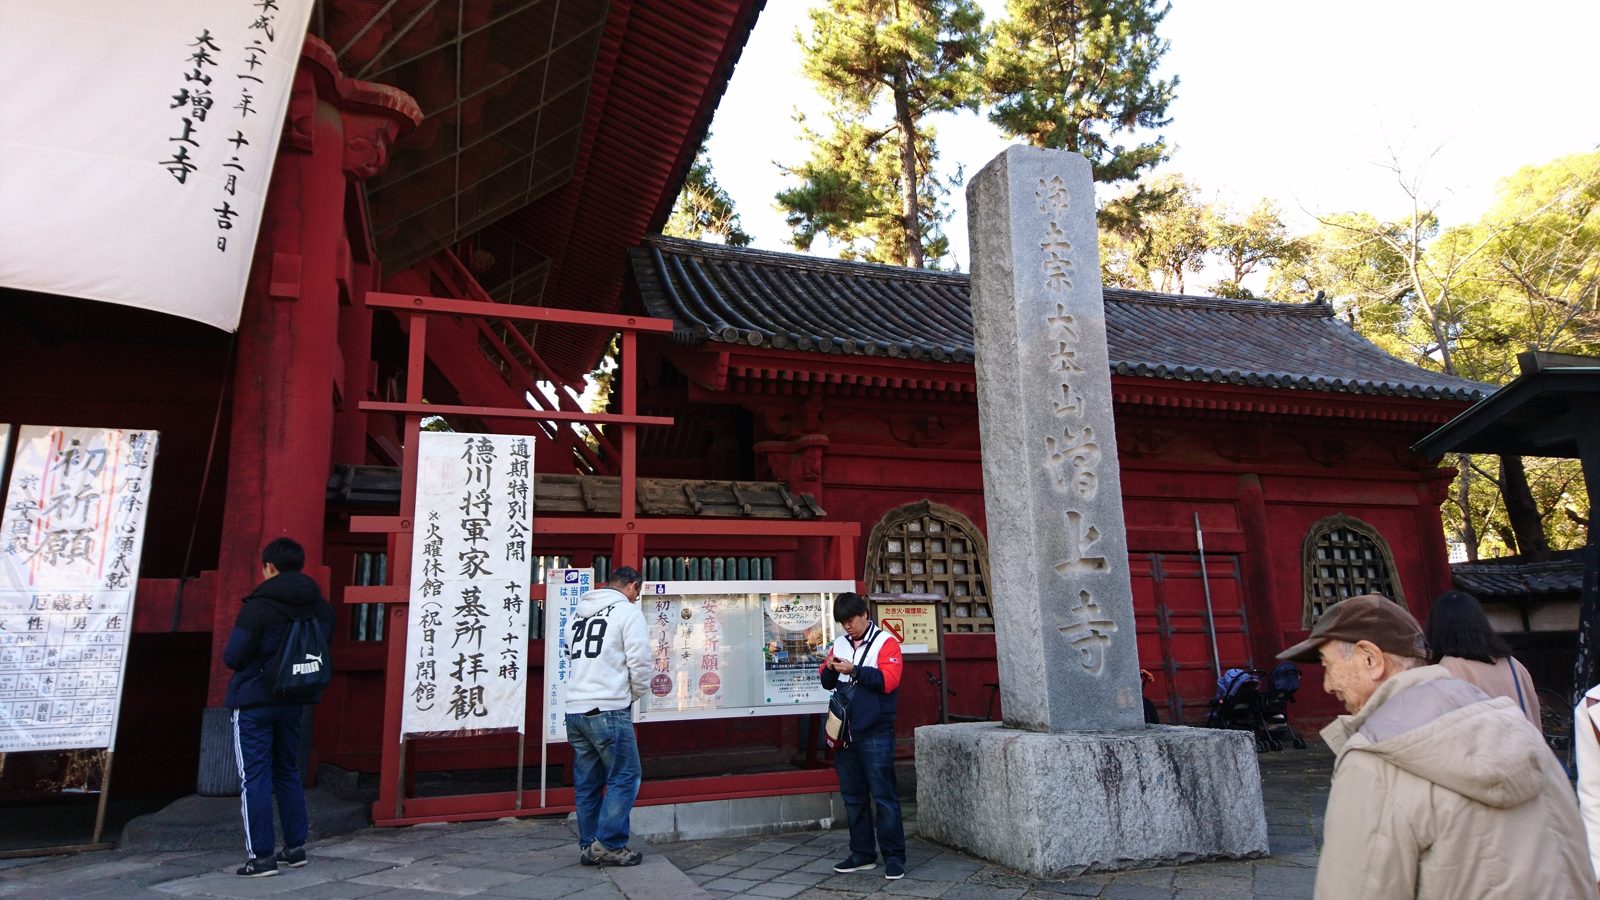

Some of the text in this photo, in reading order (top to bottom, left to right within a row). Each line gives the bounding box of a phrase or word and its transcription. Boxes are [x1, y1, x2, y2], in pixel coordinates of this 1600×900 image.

[159, 28, 221, 184] 大本山増上寺
[22, 438, 107, 567] 初祈願
[506, 438, 531, 562] 通期特別公開
[446, 436, 497, 720] 徳川将軍家墓所拝観
[292, 661, 320, 675] PUMA
[571, 618, 608, 659] 28
[654, 597, 671, 673] 初参り祈願
[701, 597, 720, 671] 安産祈願
